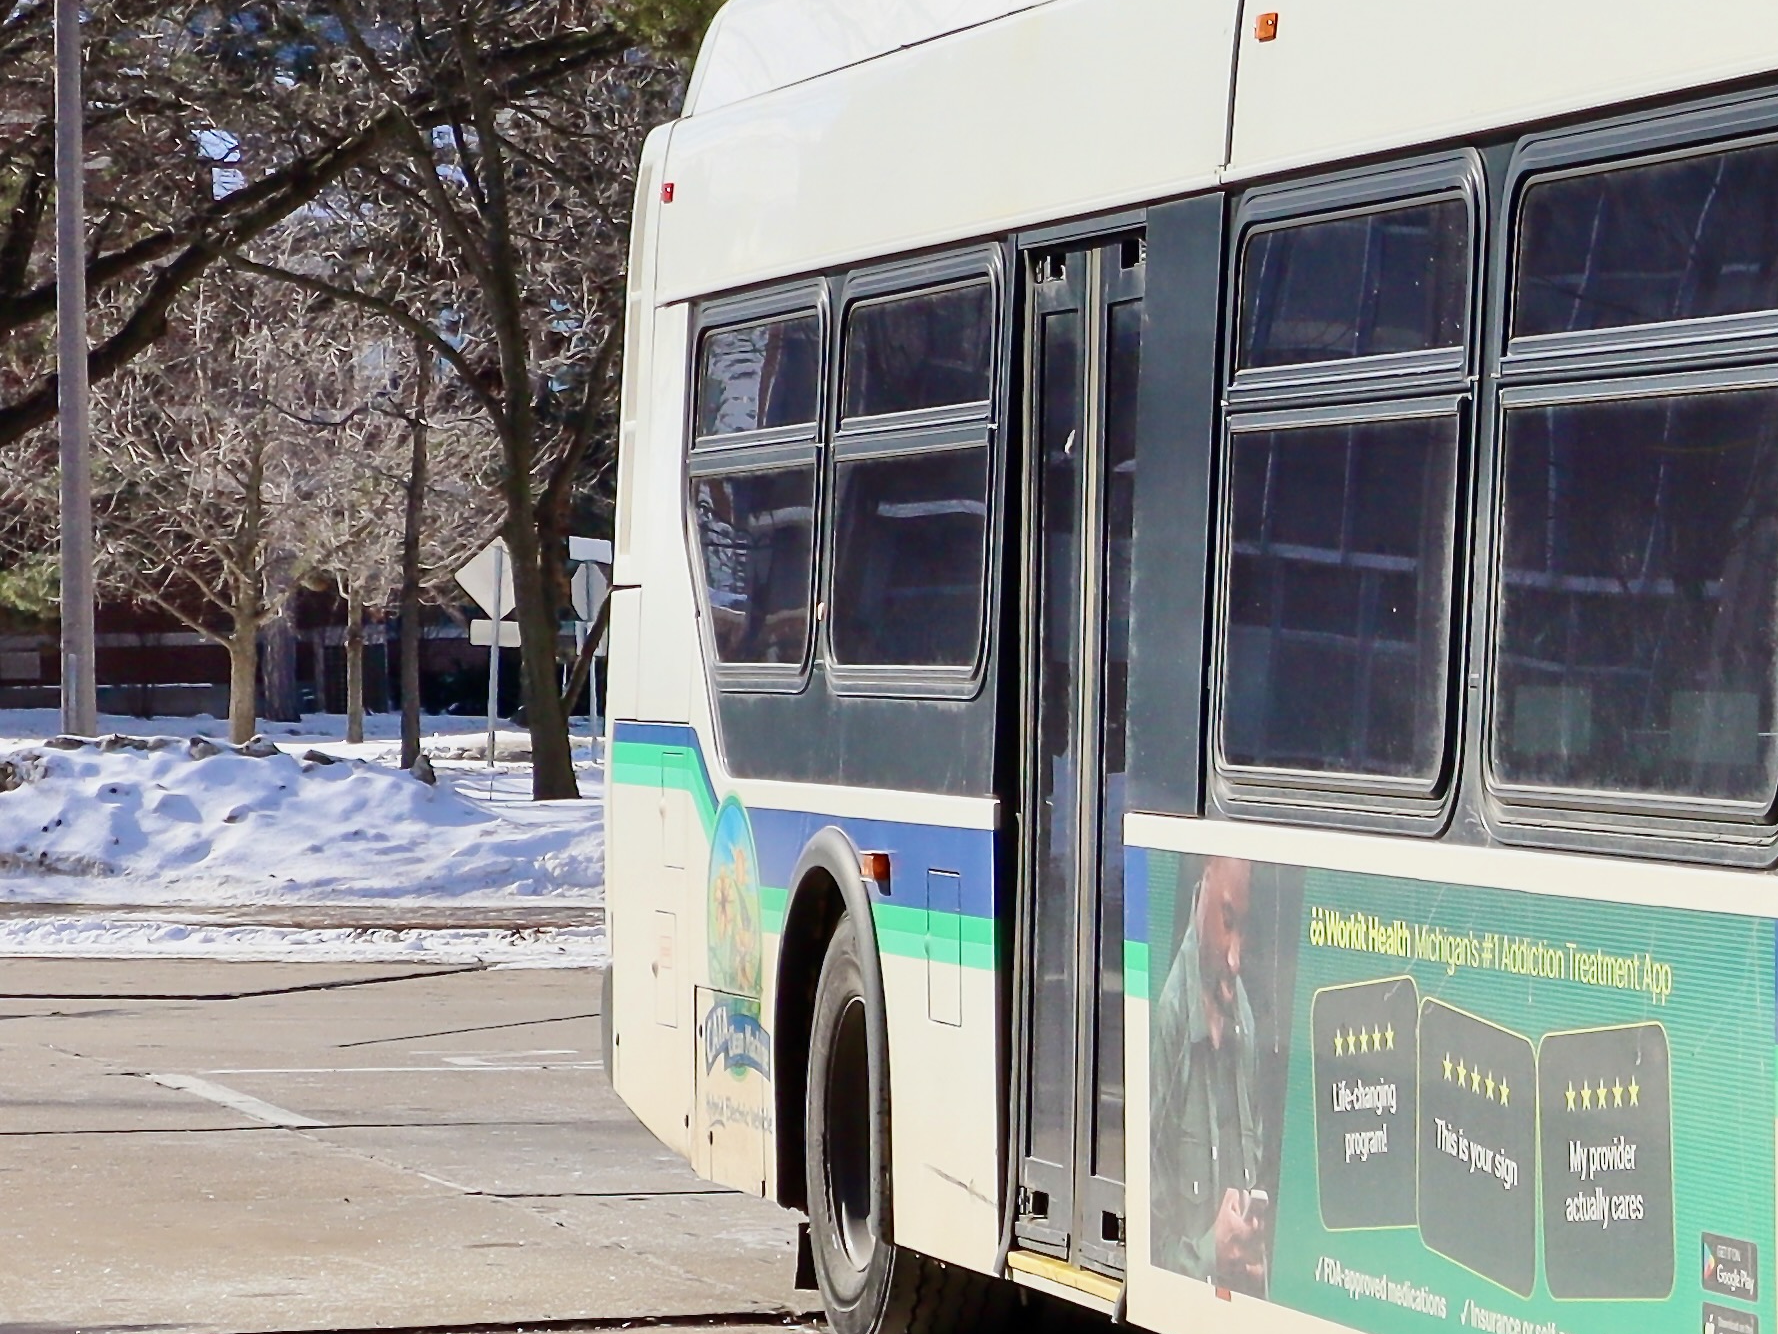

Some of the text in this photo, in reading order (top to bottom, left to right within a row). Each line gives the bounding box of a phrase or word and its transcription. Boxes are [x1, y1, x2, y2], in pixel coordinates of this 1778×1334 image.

[1325, 909, 1672, 1007] Workit Health Michigan's #1 Addiction Treatment App
[1332, 1078, 1396, 1116] Life-changing
[1345, 1123, 1387, 1163] program!
[1434, 1118, 1518, 1189] This is your sign
[1569, 1136, 1637, 1181] My provider
[1566, 1187, 1644, 1229] actually cares
[1323, 1256, 1447, 1319] FDA-approved medications
[1716, 1264, 1755, 1295] Google Play
